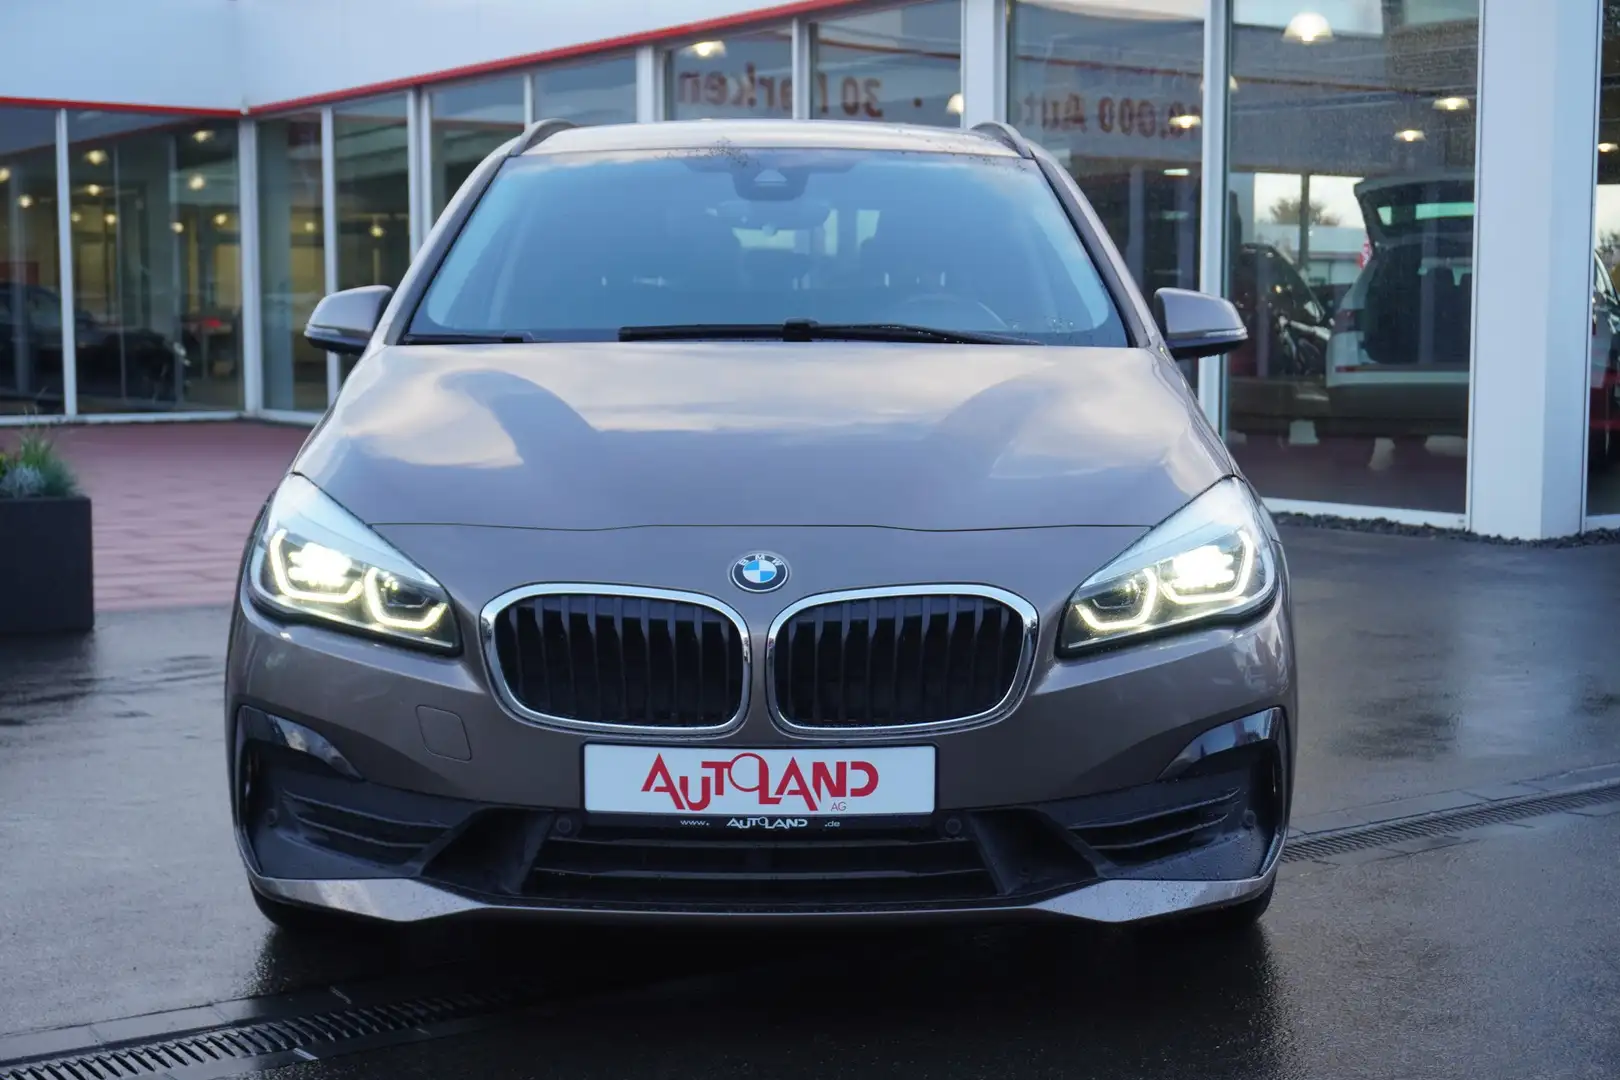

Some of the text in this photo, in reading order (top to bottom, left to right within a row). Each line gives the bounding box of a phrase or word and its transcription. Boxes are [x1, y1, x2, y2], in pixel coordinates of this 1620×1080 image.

[738, 553, 783, 566] BMW
[640, 752, 879, 812] AUTOLAND
[830, 801, 847, 812] AG
[680, 819, 709, 827] www.
[727, 816, 808, 830] AUTOLAND
